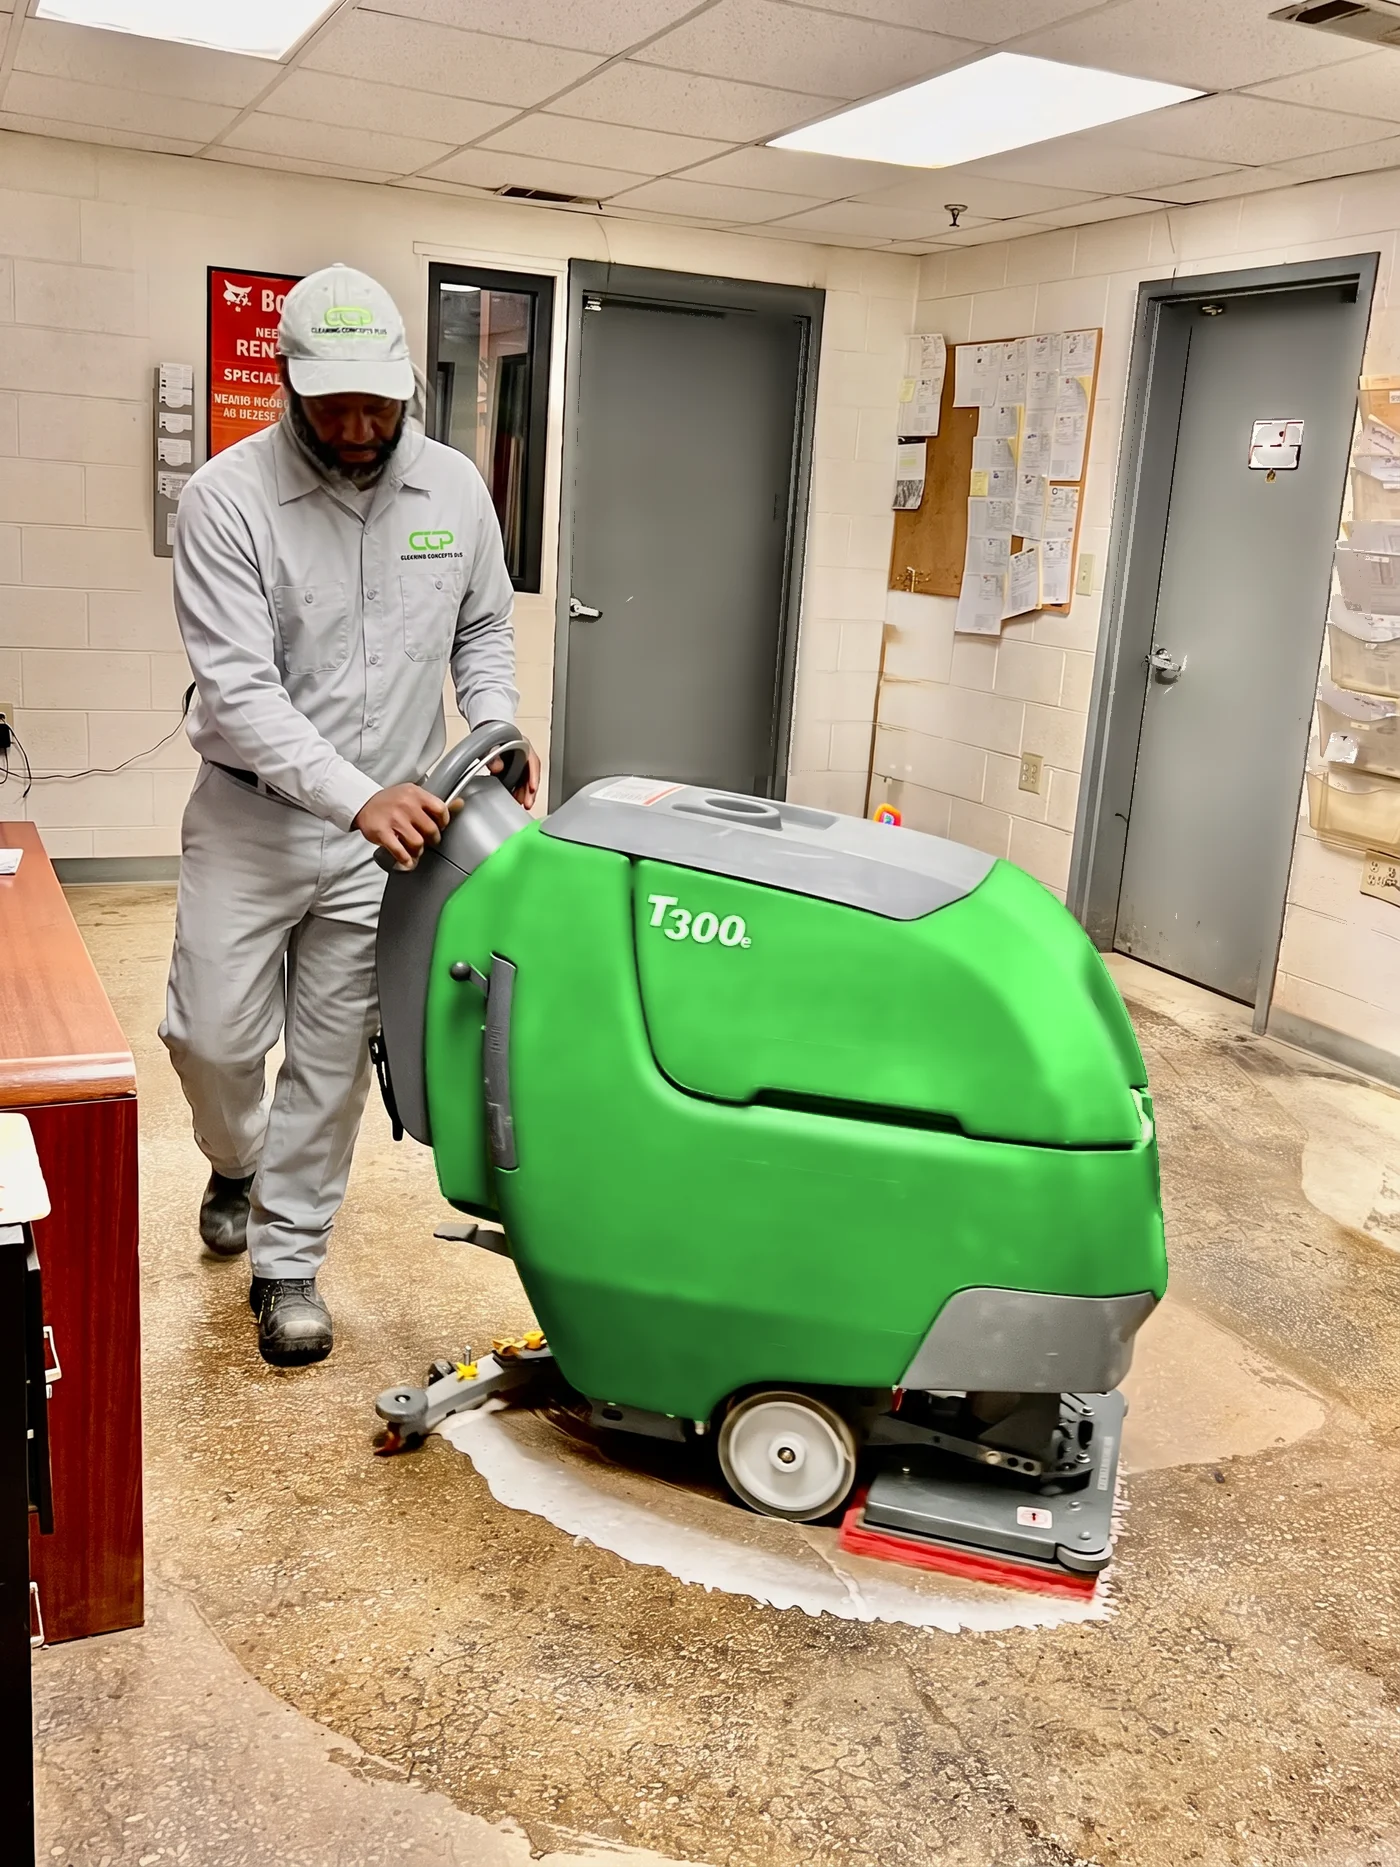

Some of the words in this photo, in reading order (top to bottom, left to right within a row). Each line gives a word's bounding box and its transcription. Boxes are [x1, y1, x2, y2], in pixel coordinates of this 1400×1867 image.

[261, 289, 285, 315] Bo
[255, 327, 280, 340] NEE
[236, 338, 276, 359] REN
